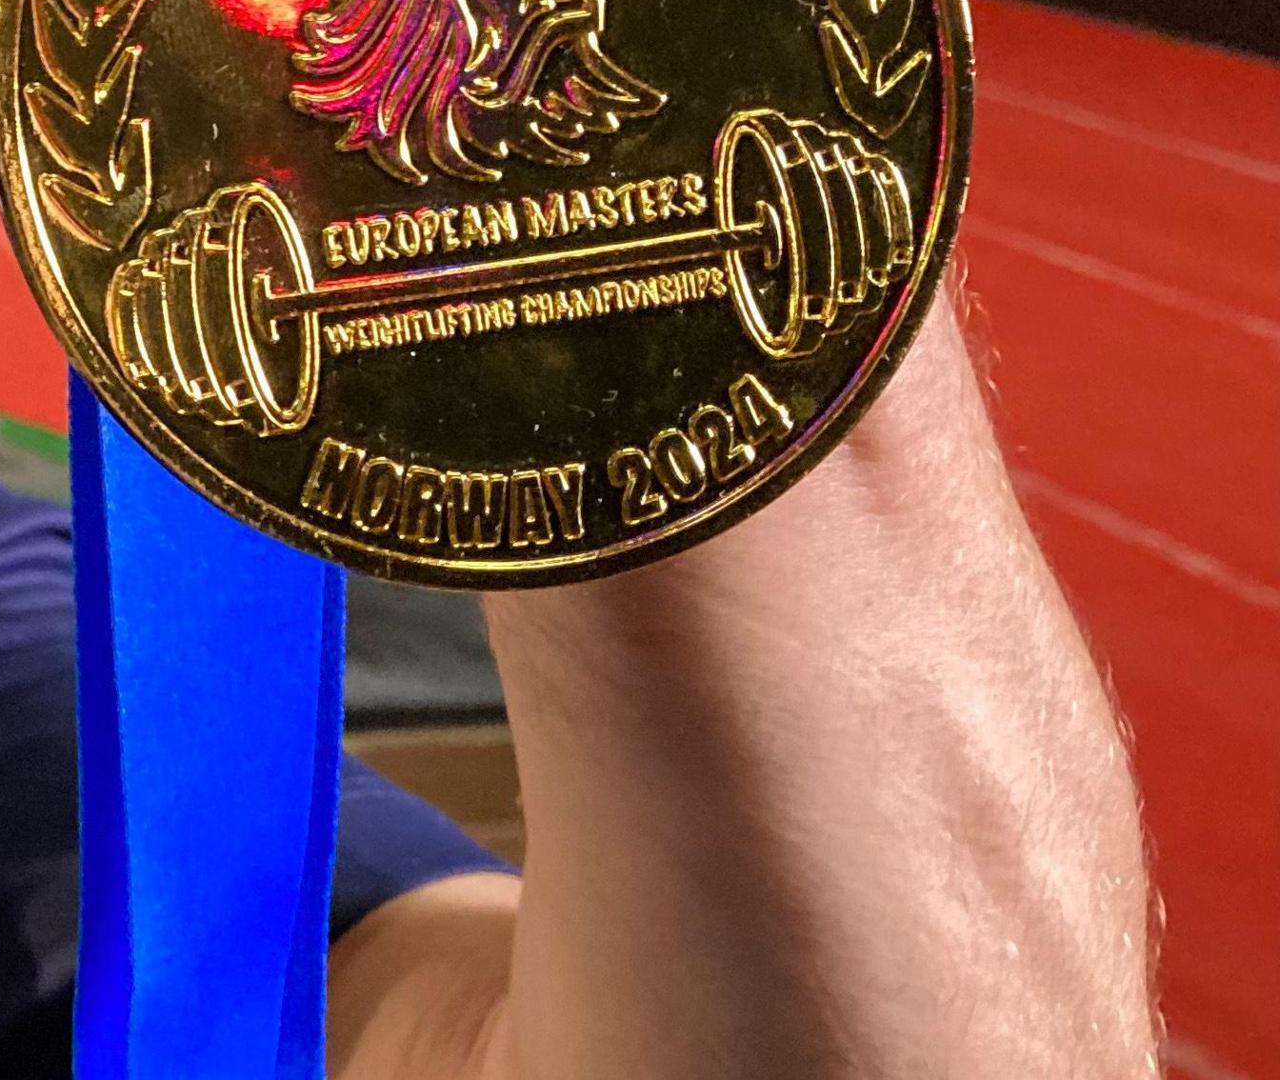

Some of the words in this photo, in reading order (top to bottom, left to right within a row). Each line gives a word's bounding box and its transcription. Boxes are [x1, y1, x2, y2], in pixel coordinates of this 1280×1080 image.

[321, 199, 518, 268] EUROPEAN
[520, 173, 707, 238] MASTERS
[323, 298, 516, 354] WEIGHTLIFTING
[520, 266, 728, 324] CHAMPIONSHIPS
[301, 437, 586, 549] NORWAY
[607, 373, 794, 525] 2024
